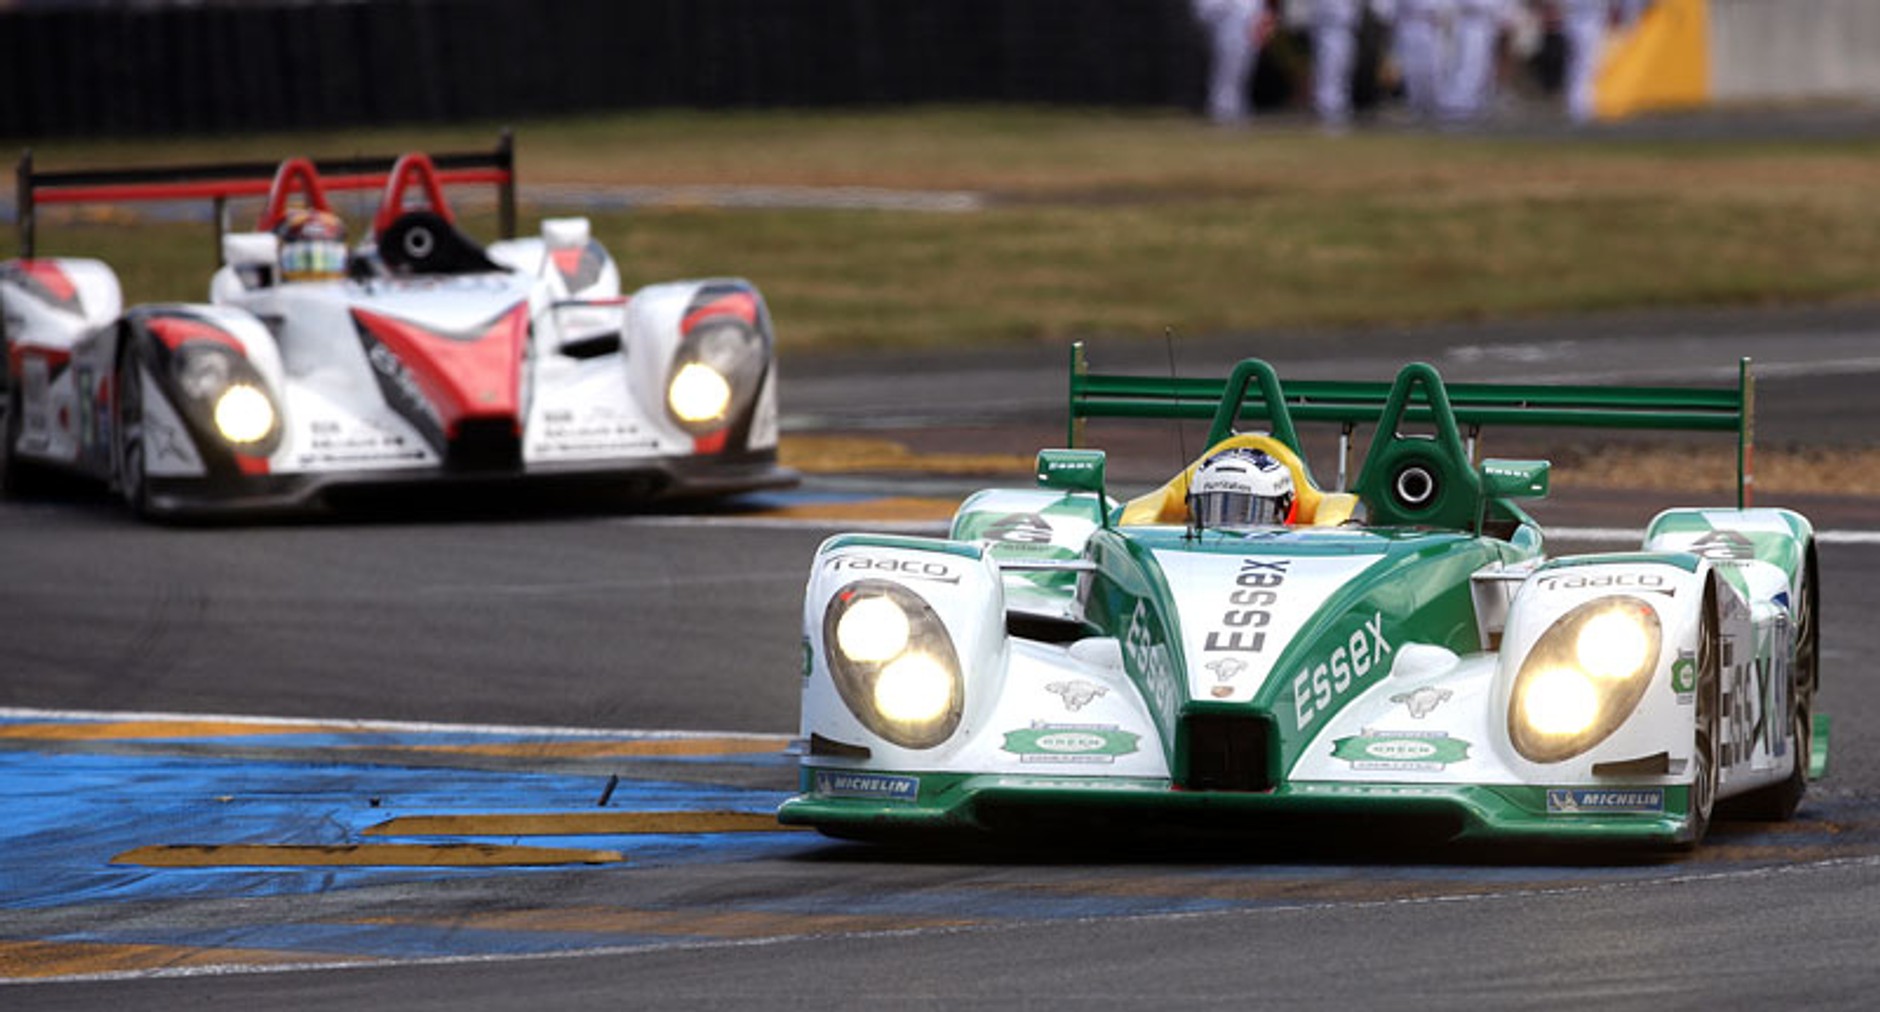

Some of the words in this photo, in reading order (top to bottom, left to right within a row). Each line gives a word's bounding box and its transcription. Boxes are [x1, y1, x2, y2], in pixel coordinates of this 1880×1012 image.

[1204, 558, 1291, 654] Essex
[1292, 611, 1392, 732] Essex
[835, 777, 910, 793] MICHELIN
[1583, 793, 1660, 806] MICHELIN
